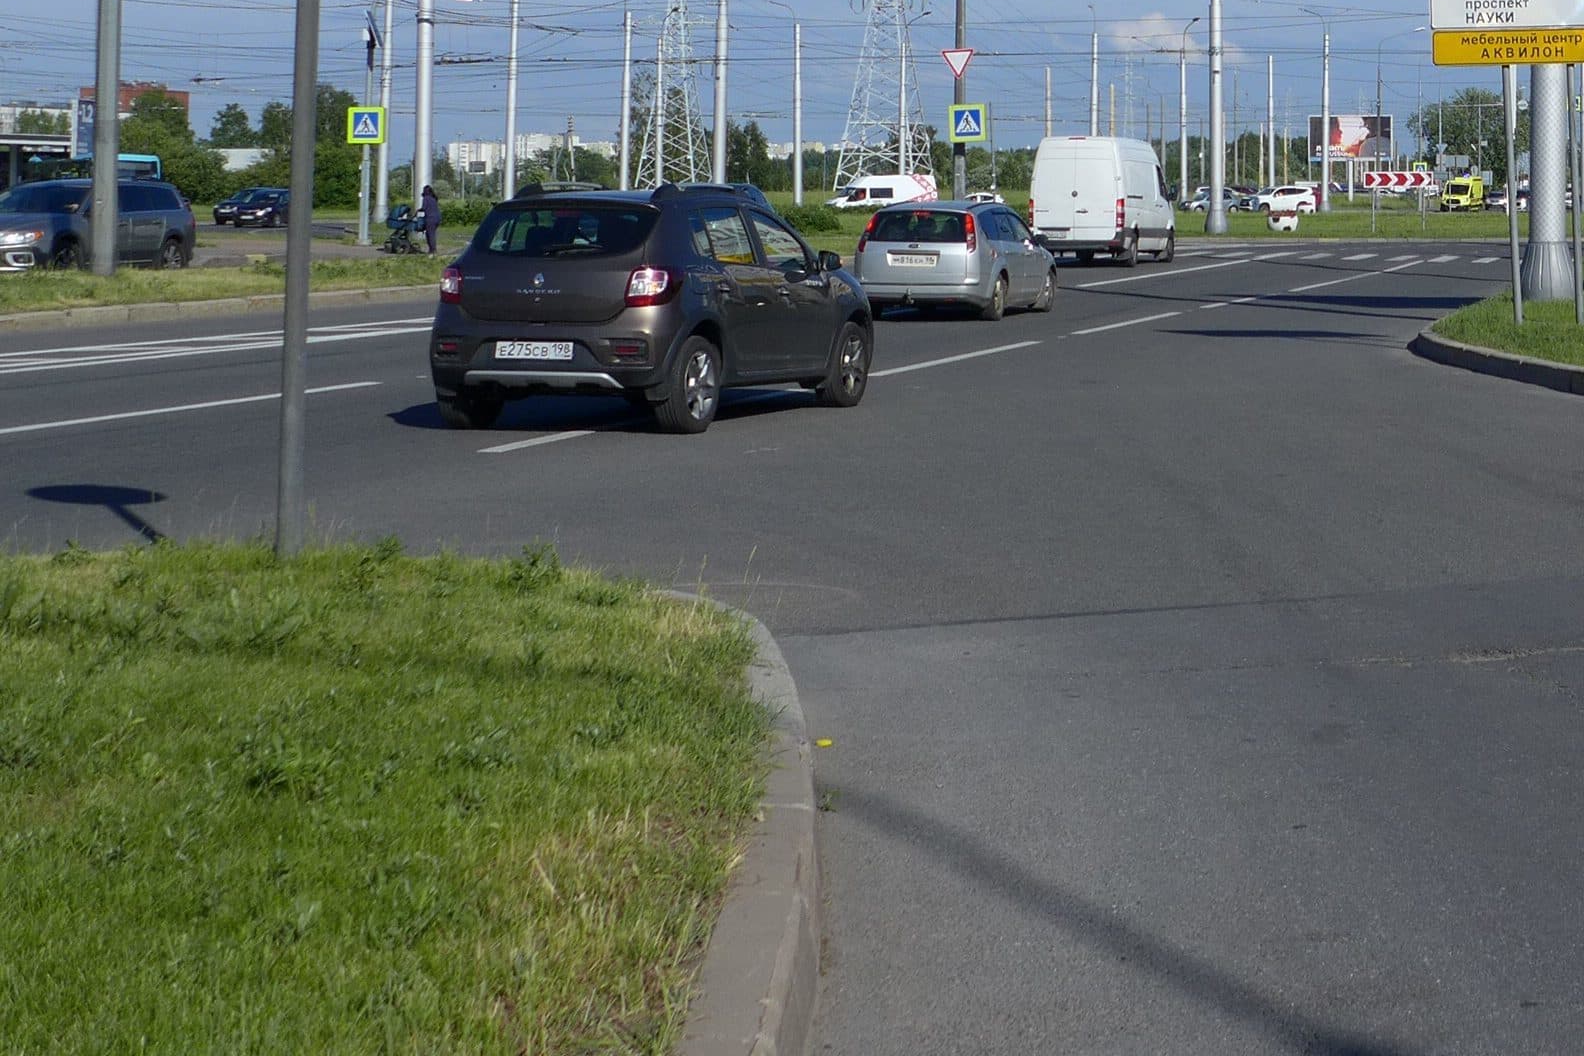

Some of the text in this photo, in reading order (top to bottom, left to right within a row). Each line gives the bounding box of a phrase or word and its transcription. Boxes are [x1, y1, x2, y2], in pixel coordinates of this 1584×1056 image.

[1466, 11, 1515, 24] НАУКИ
[1461, 32, 1583, 45] мебельный центр
[1481, 47, 1564, 59] АКВИЛОН
